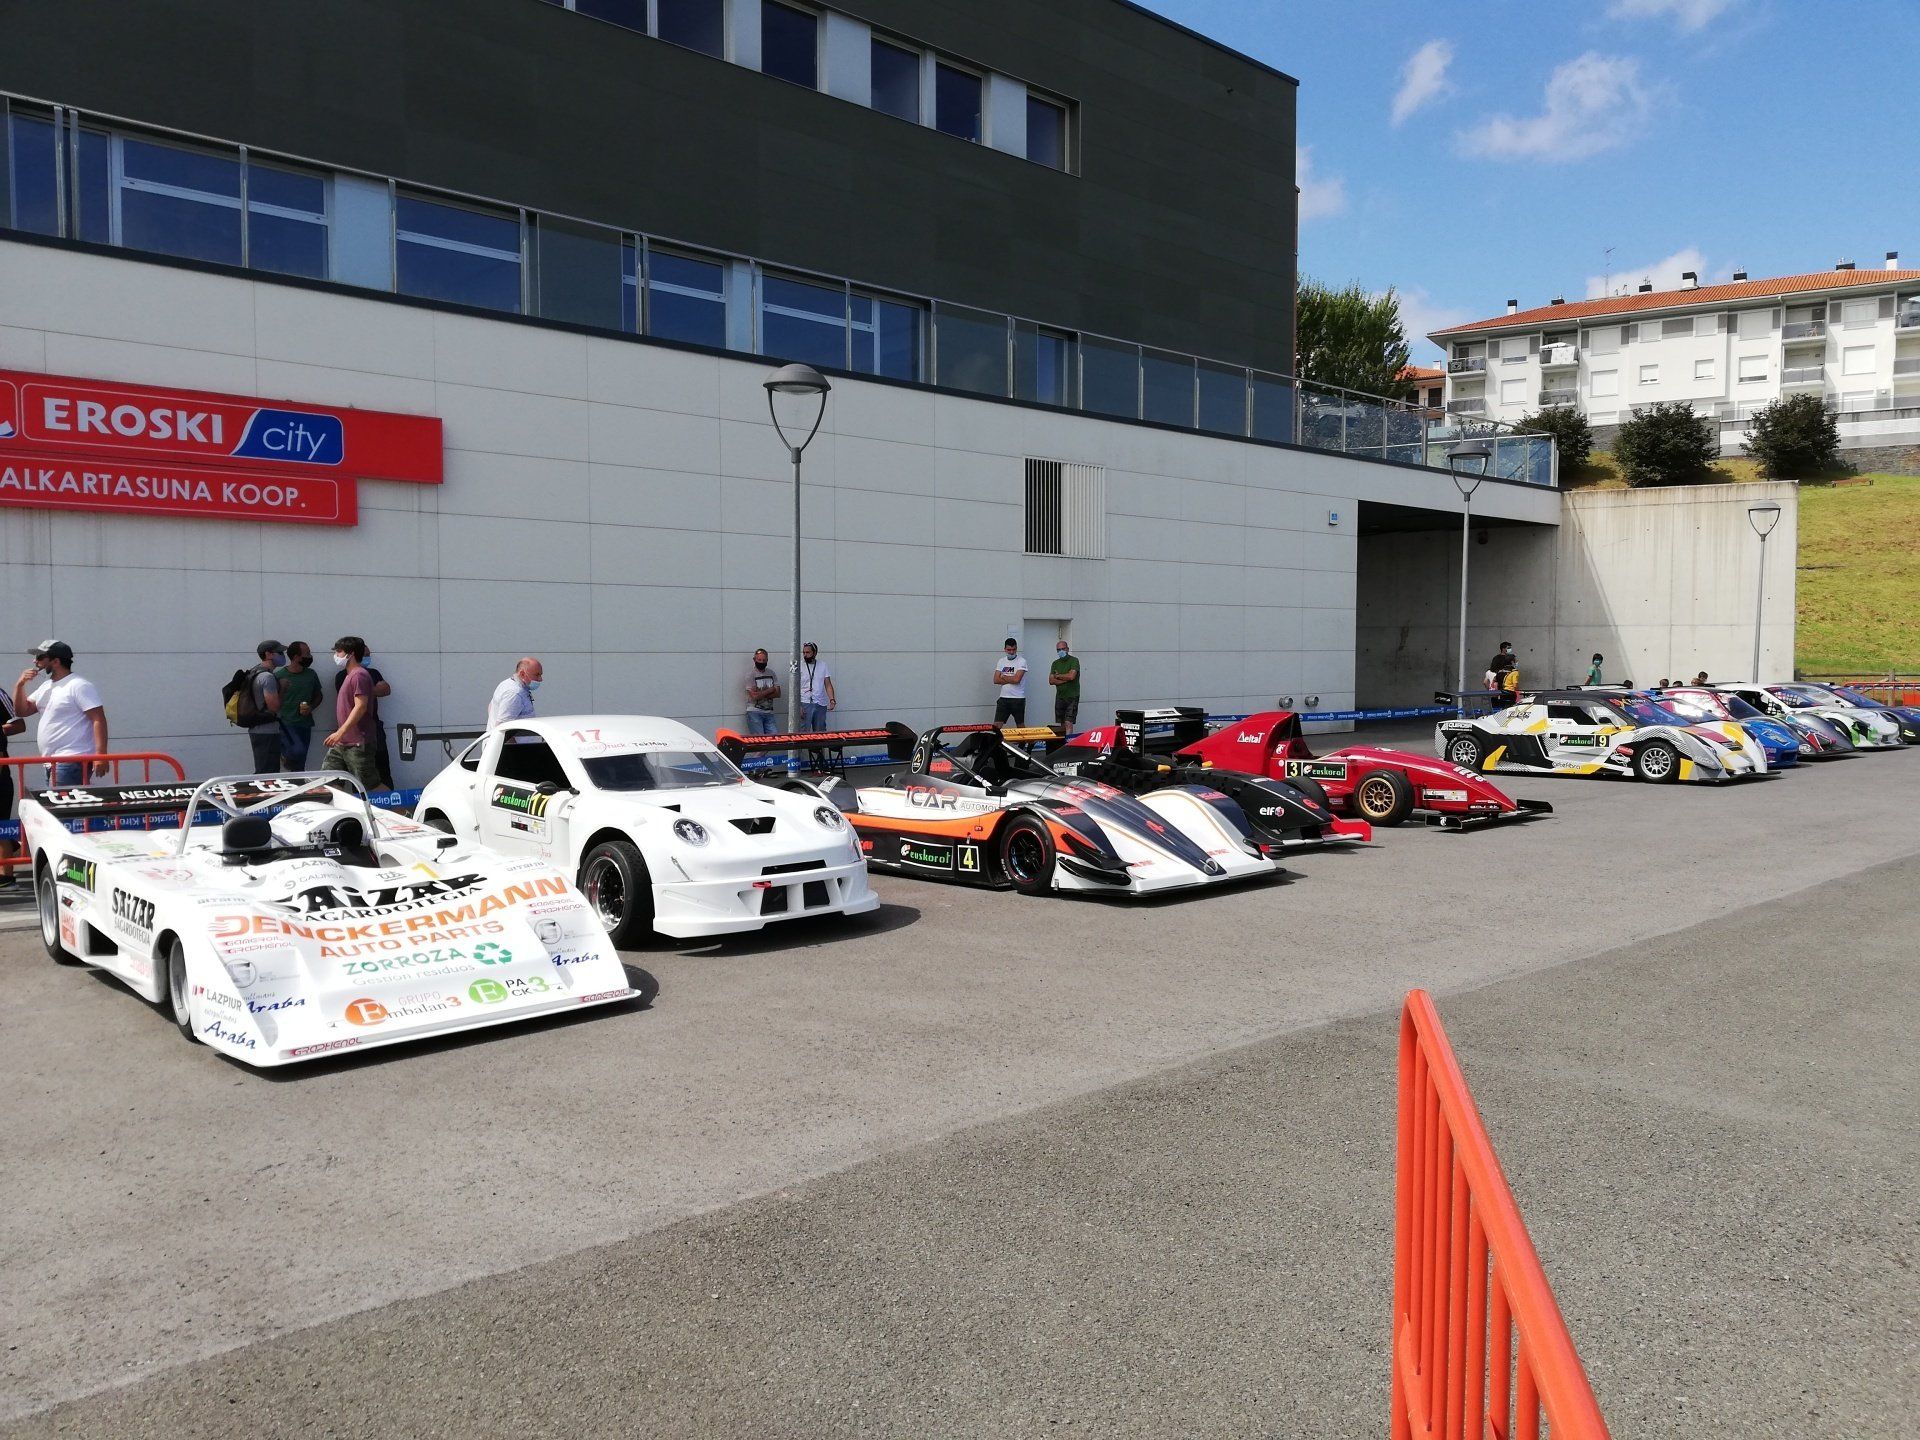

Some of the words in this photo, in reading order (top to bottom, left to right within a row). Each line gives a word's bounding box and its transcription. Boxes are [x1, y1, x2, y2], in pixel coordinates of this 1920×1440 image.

[43, 397, 223, 444] EROSKI
[262, 422, 326, 460] city
[0, 467, 212, 502] ALKARTASUNA
[222, 483, 306, 508] KOOP.
[402, 728, 413, 753] 12
[571, 729, 601, 743] 17
[1599, 735, 1607, 747] 9
[1289, 762, 1299, 777] 3
[530, 792, 551, 817] 17
[906, 786, 960, 811] ICAR
[1260, 806, 1275, 816] elf
[964, 848, 974, 870] 4
[411, 863, 440, 880] 1
[209, 876, 568, 942] DENCKERMANN
[320, 939, 402, 958] AUTO
[408, 920, 504, 946] PARTS
[342, 947, 467, 976] ZORROZA
[551, 952, 600, 967] Araba
[416, 964, 476, 979] residuos
[505, 978, 527, 988] PA
[511, 988, 533, 997] CK
[206, 988, 243, 1013] LAZPIUR
[398, 991, 441, 1006] GRUPO
[204, 1020, 257, 1050] Araba
